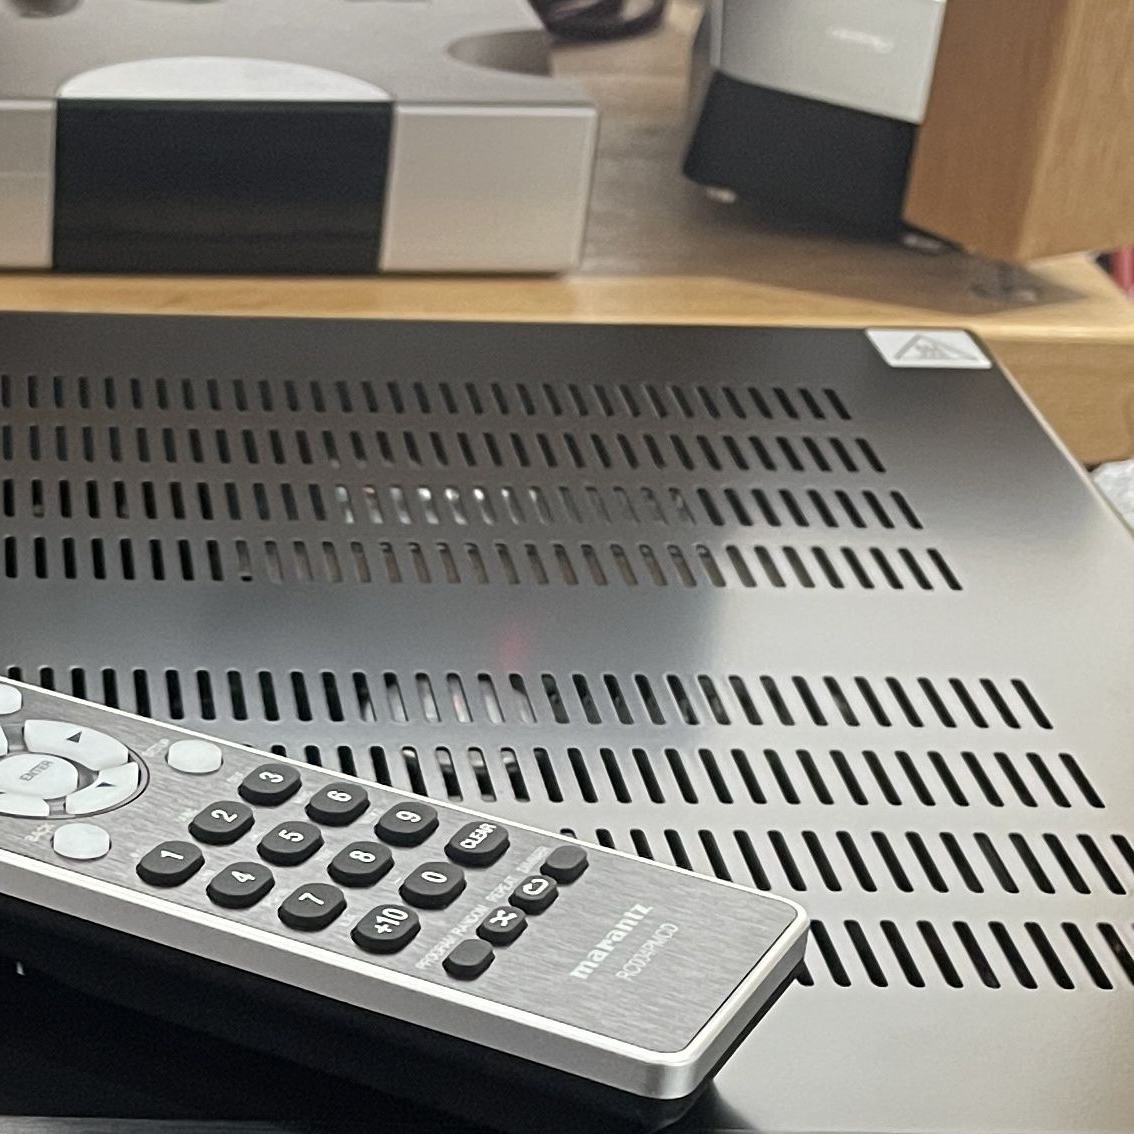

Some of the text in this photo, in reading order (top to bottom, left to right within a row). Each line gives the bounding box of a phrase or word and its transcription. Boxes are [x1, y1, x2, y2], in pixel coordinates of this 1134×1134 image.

[19, 760, 53, 782] ENTER
[259, 771, 284, 783] 3
[327, 790, 352, 802] 6
[211, 809, 238, 823] 2
[395, 810, 422, 823] 9
[278, 829, 304, 842] 5
[460, 823, 497, 849] CLEAR
[161, 850, 184, 860] 1
[349, 850, 376, 863] 8
[231, 870, 256, 883] 4
[421, 871, 448, 883] 0
[298, 892, 325, 906] 7
[374, 908, 409, 934] +10
[570, 904, 653, 980] marantz
